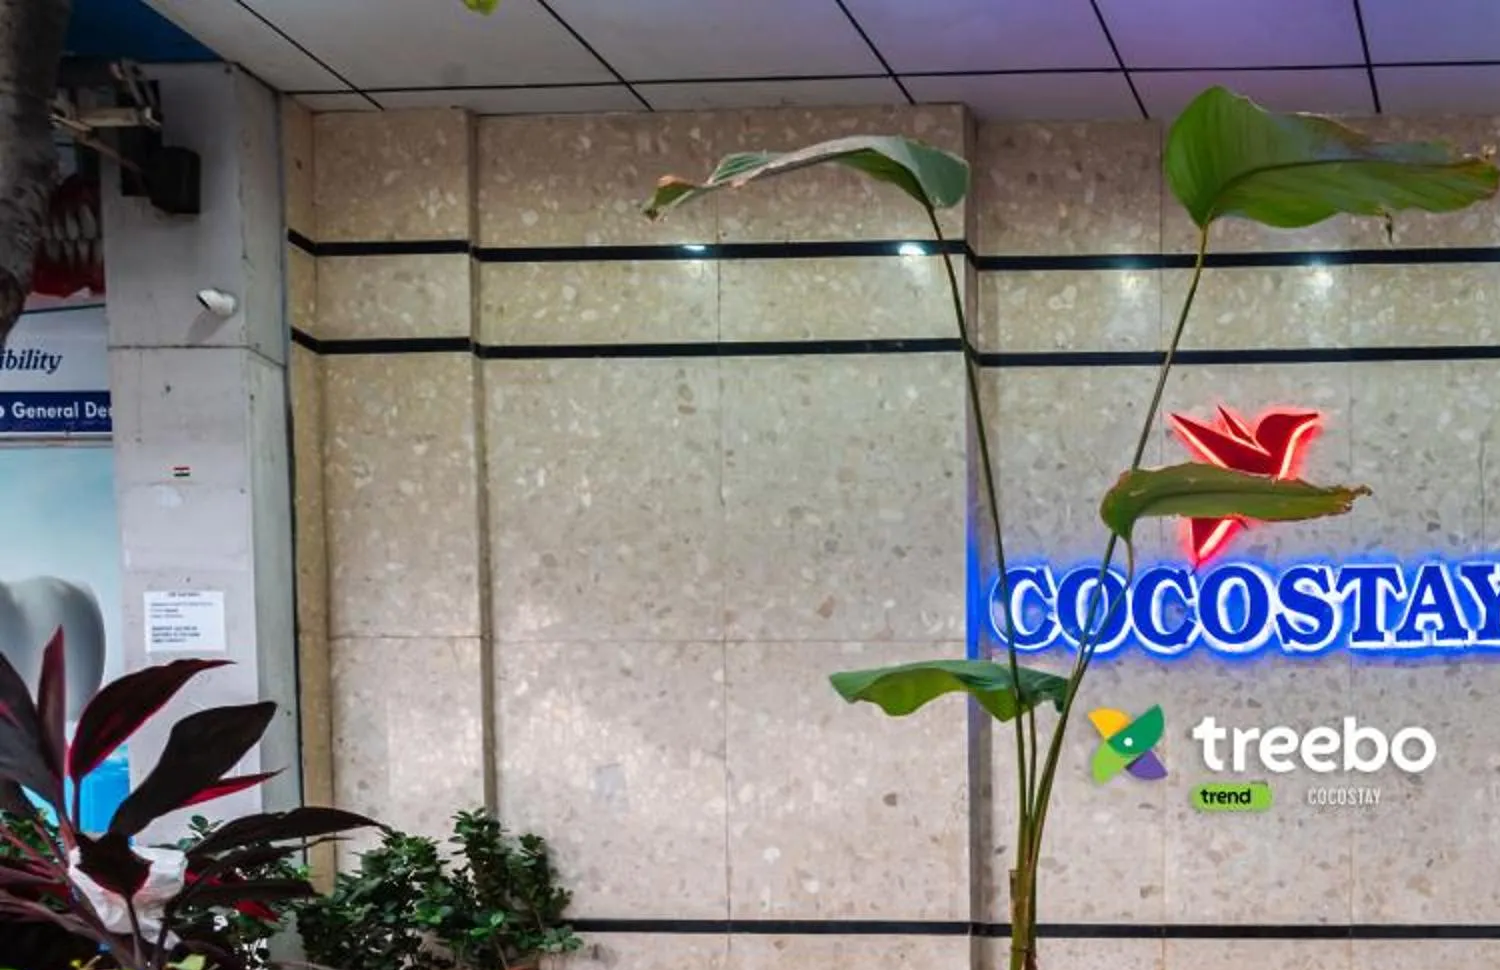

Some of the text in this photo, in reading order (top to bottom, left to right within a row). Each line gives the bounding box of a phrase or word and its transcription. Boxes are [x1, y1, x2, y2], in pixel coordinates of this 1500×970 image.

[11, 401, 79, 418] General
[1193, 716, 1437, 773] treebo
[1201, 789, 1251, 805] trend
[1308, 788, 1381, 805] COCOSTAY
